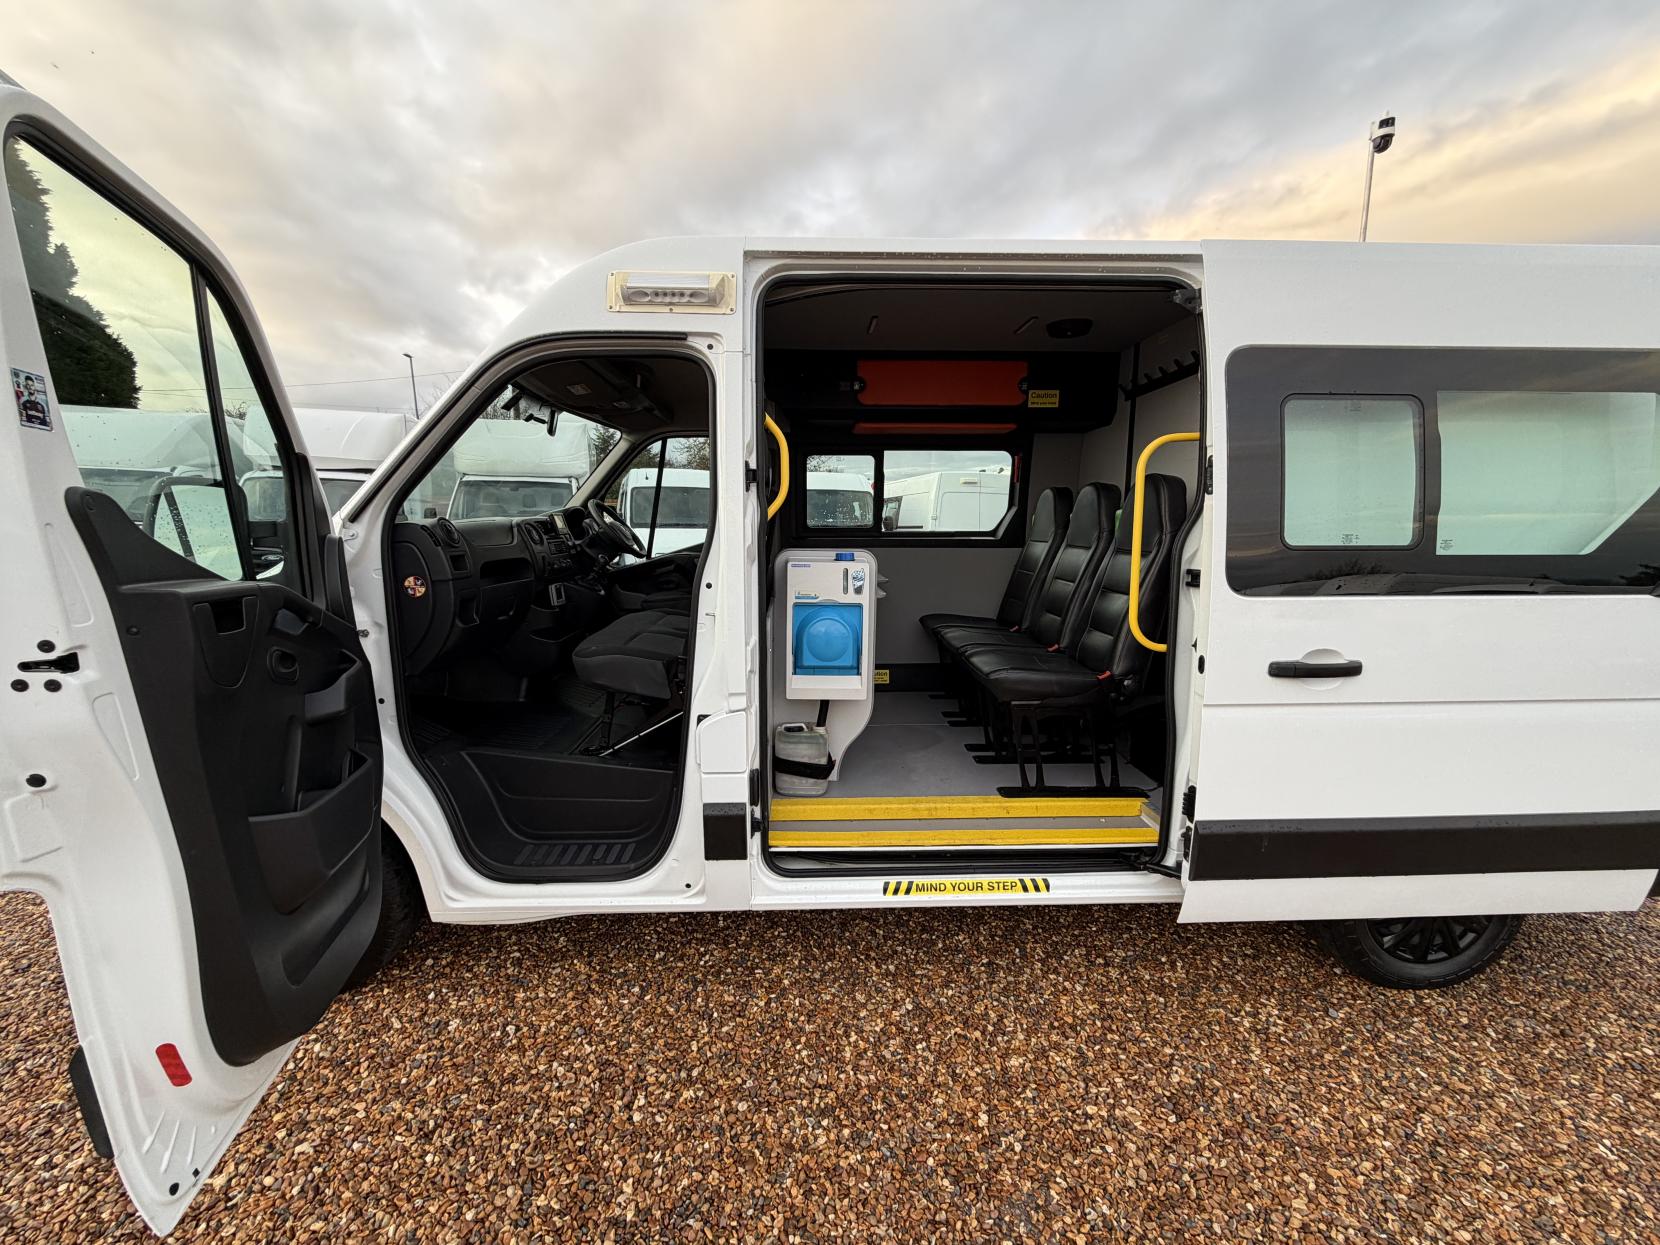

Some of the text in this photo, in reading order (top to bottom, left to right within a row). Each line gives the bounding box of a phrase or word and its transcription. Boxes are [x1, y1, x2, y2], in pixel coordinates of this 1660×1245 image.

[1031, 391, 1057, 399] Caution
[915, 880, 1018, 893] MIND YOUR STEP
